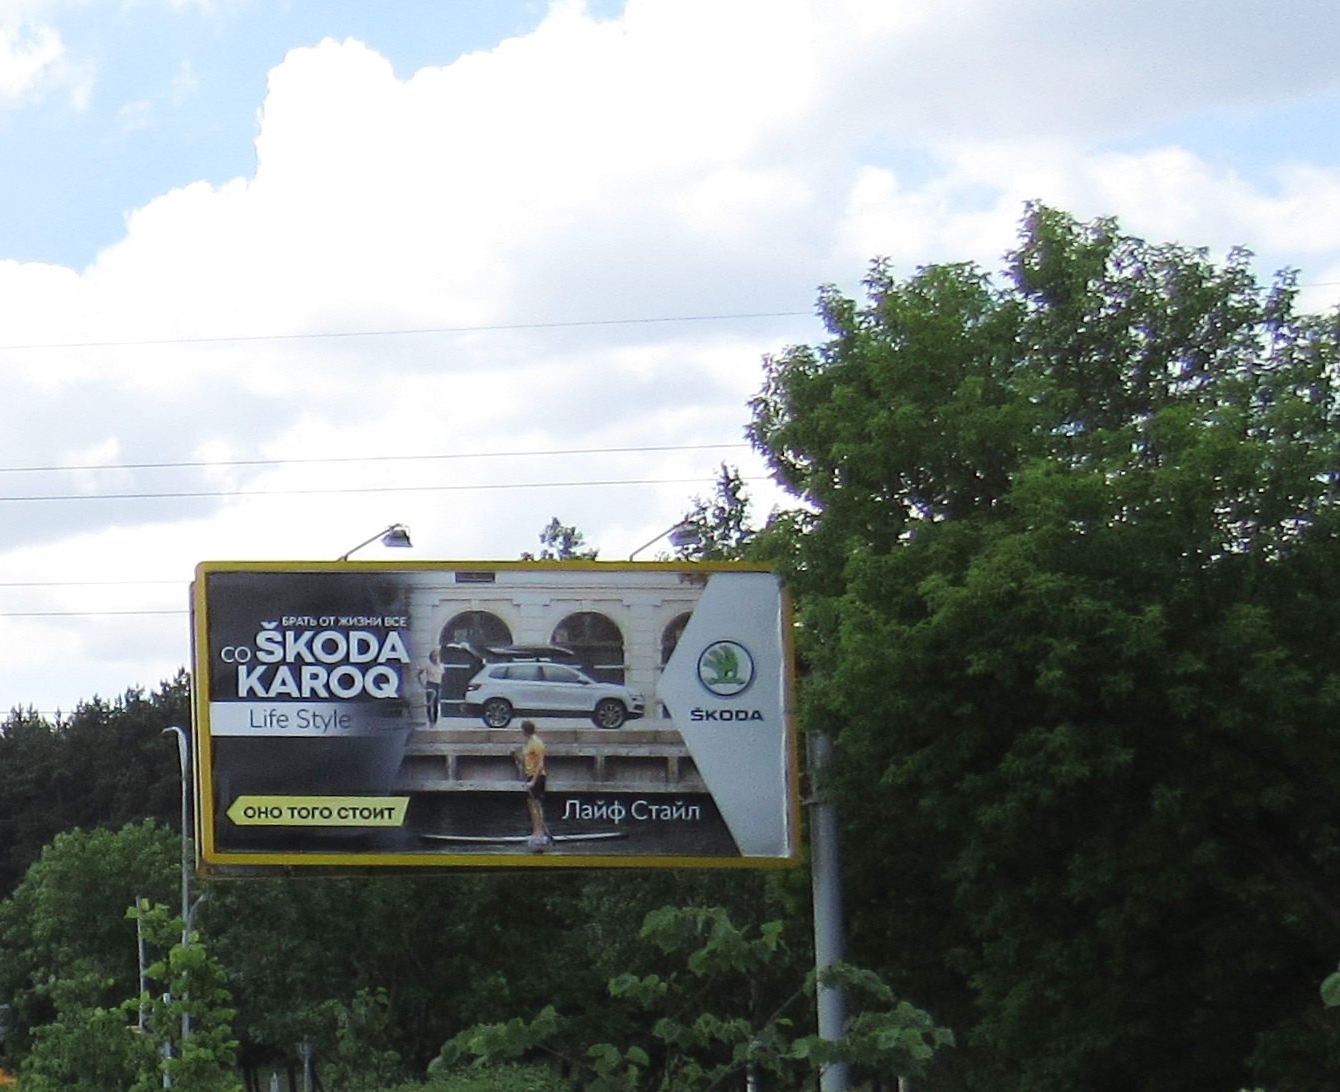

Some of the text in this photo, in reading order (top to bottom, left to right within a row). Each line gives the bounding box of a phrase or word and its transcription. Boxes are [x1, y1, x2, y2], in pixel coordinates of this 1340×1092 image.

[282, 616, 407, 627] БРАТЬ ОТ ЖИЗНИ ВСЕ
[255, 621, 411, 664] ŠKODA
[237, 665, 399, 699] KAROQ
[249, 708, 352, 733] Life Style
[690, 707, 765, 722] ŠKODA
[243, 806, 396, 820] ОНО ТОГО СТОИТ
[562, 800, 700, 824] Лайф Стайл
